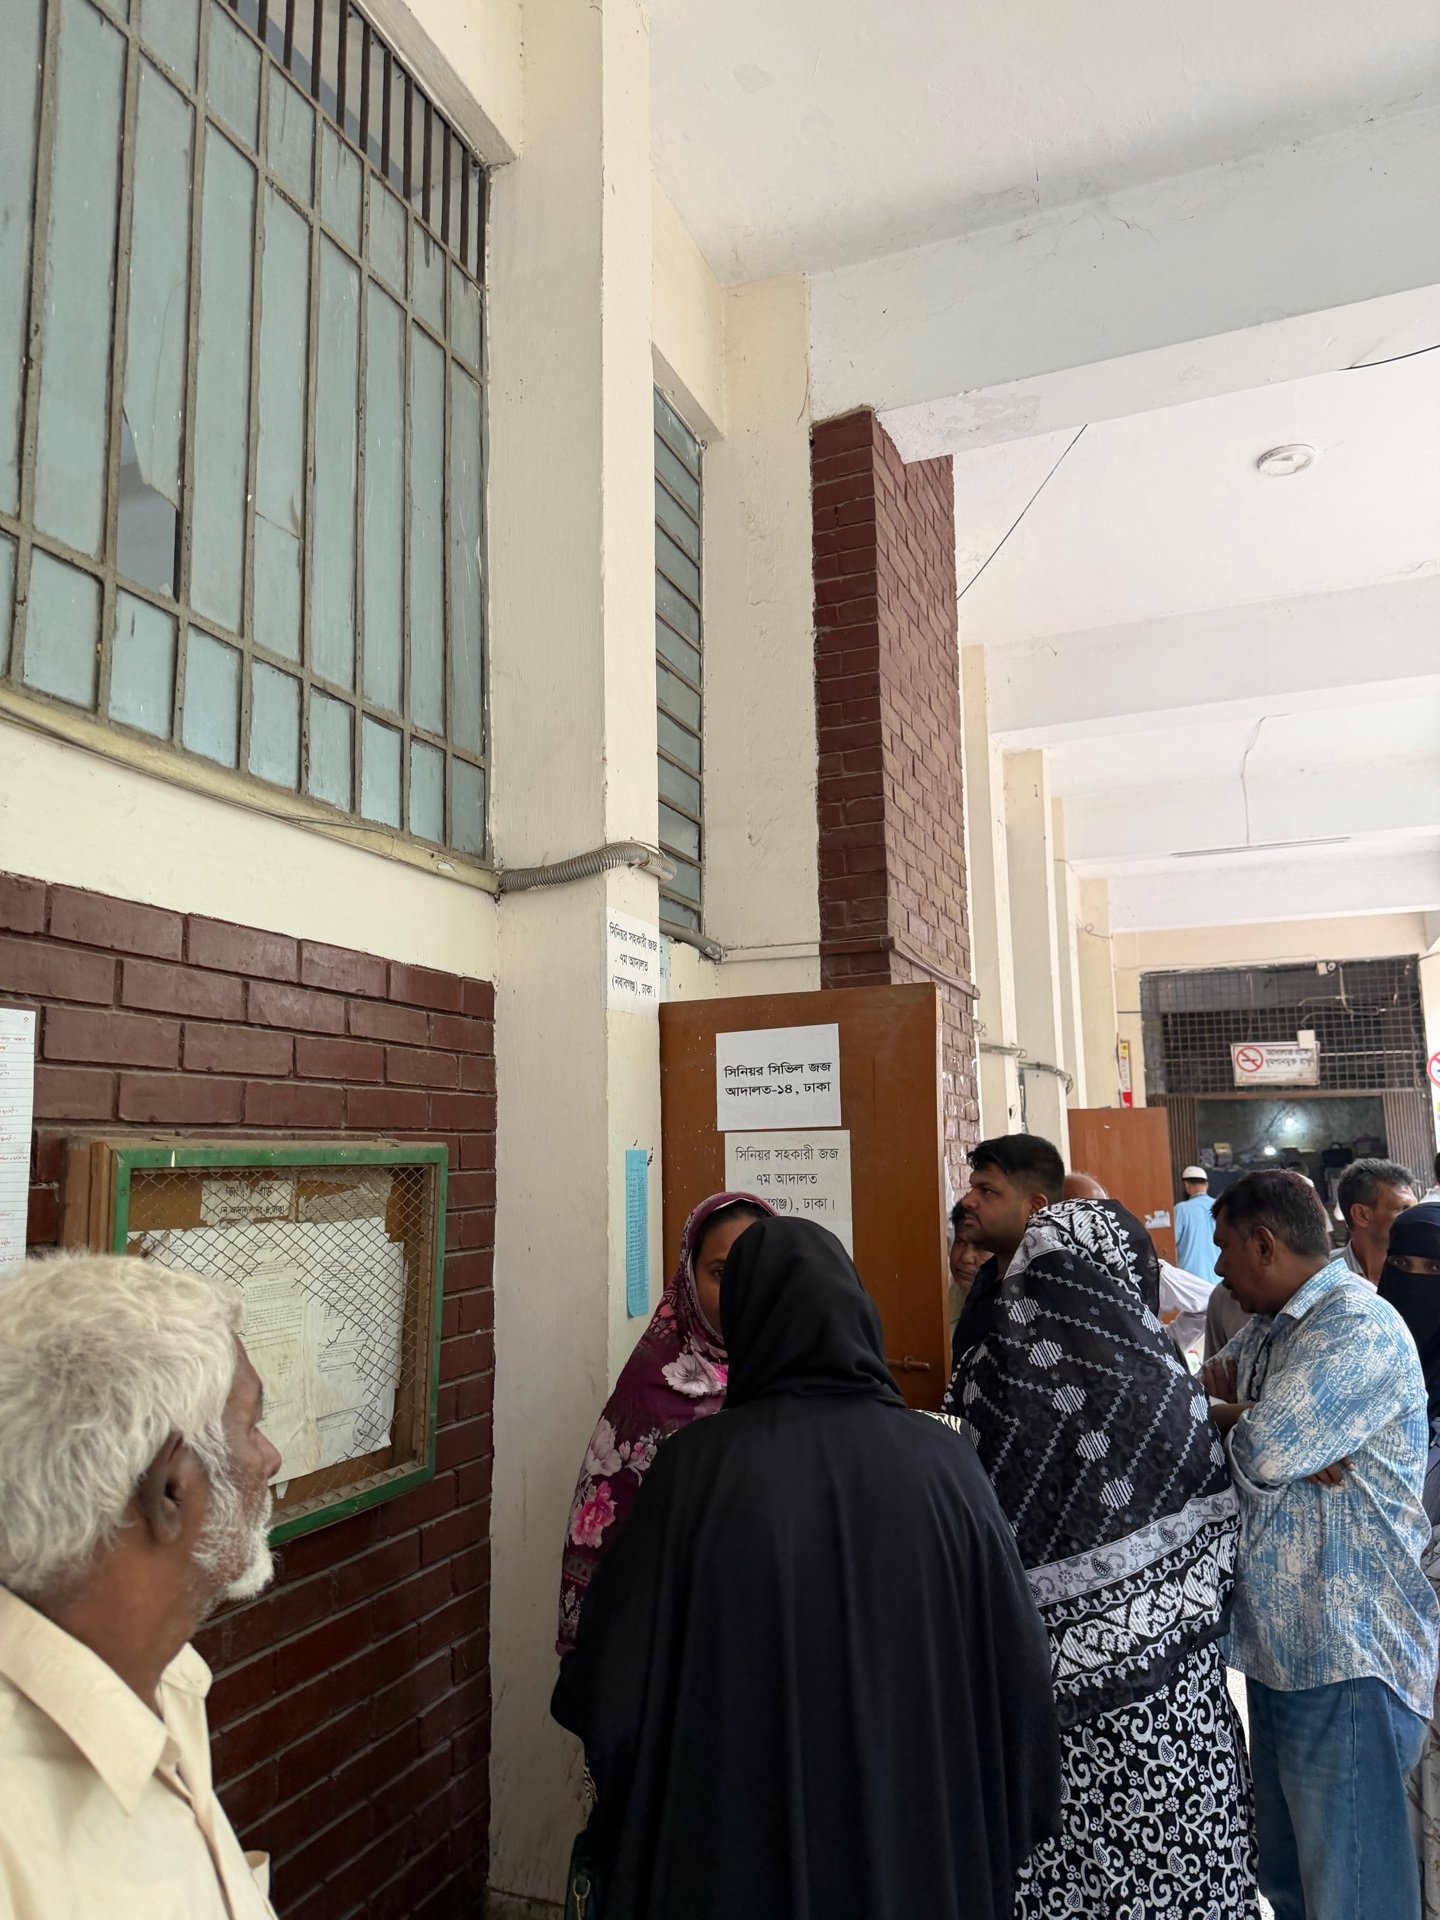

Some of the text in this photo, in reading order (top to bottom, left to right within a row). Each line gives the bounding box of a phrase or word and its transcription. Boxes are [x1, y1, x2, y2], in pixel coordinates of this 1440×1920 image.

[609, 921, 628, 942] সিনিয়র
[628, 932, 647, 950] সহকারী
[647, 939, 657, 953] জজ
[628, 955, 649, 972] আদালত
[724, 1061, 832, 1078] সিনিয়র সিভিল জজ
[803, 1081, 831, 1093] ঢাকা
[735, 1144, 839, 1161] সিনিয়র সহকারী জজ
[756, 1173, 818, 1185] ৭ম আদালত
